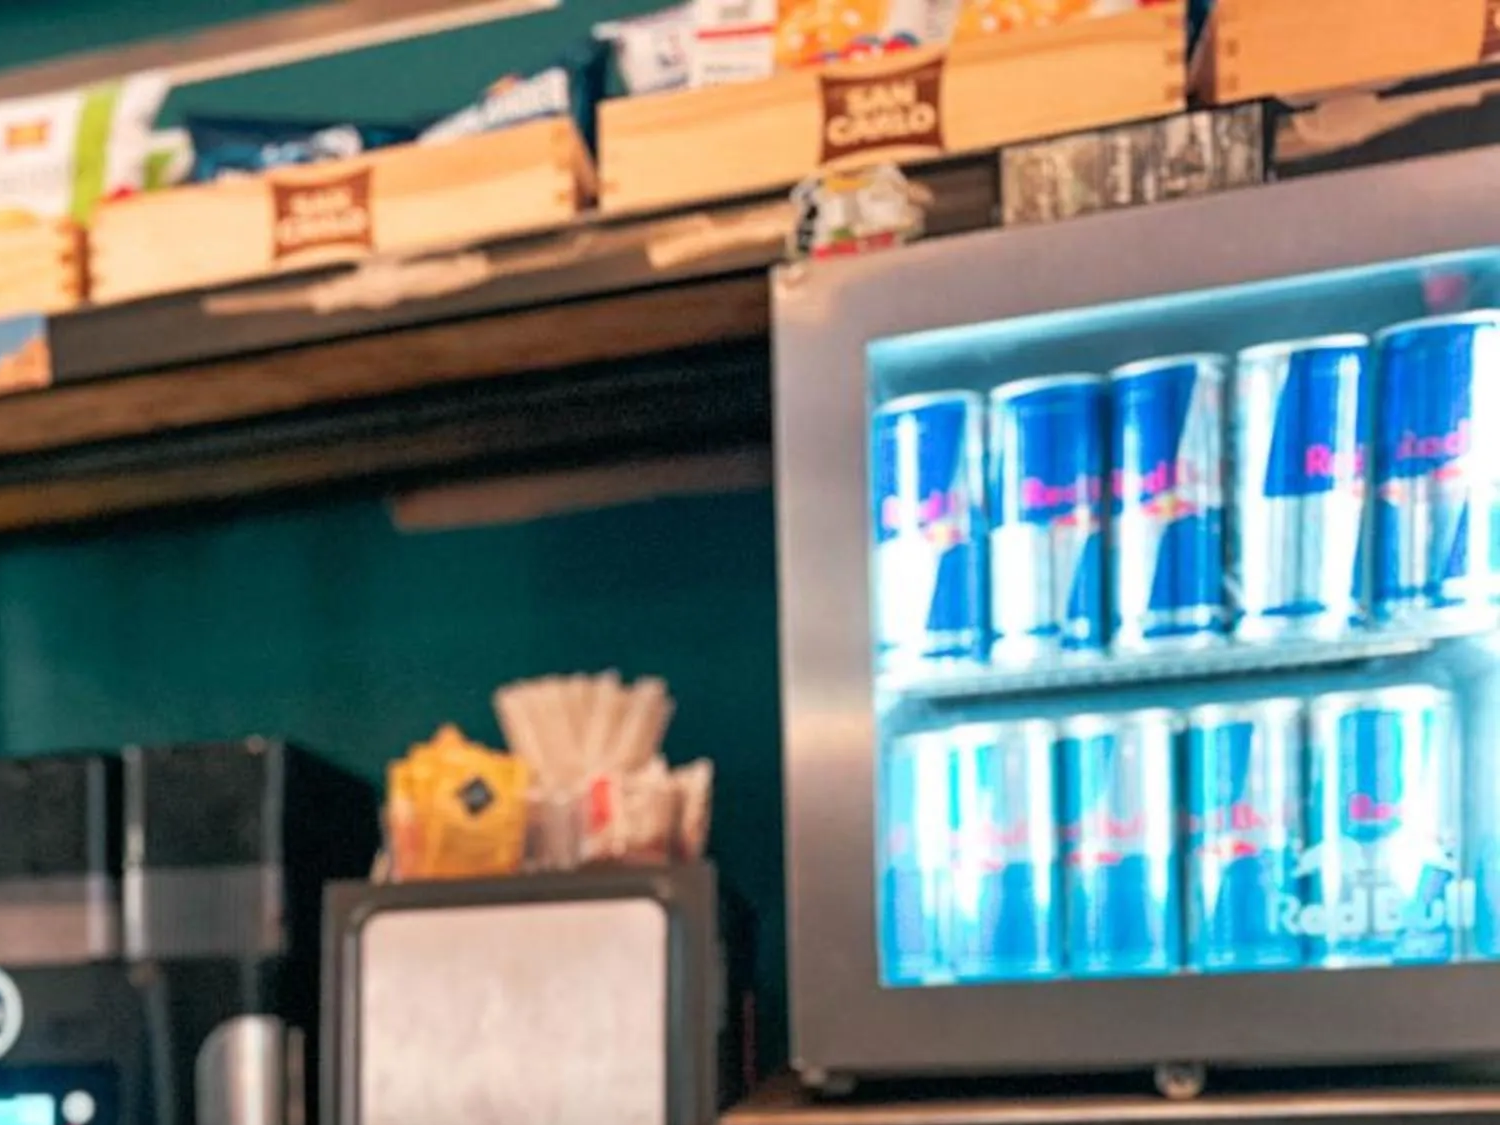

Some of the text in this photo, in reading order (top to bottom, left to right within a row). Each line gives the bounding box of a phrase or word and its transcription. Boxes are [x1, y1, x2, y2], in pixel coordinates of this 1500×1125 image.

[846, 79, 916, 116] SAN
[827, 102, 936, 147] CARLO
[1265, 885, 1368, 937] Red
